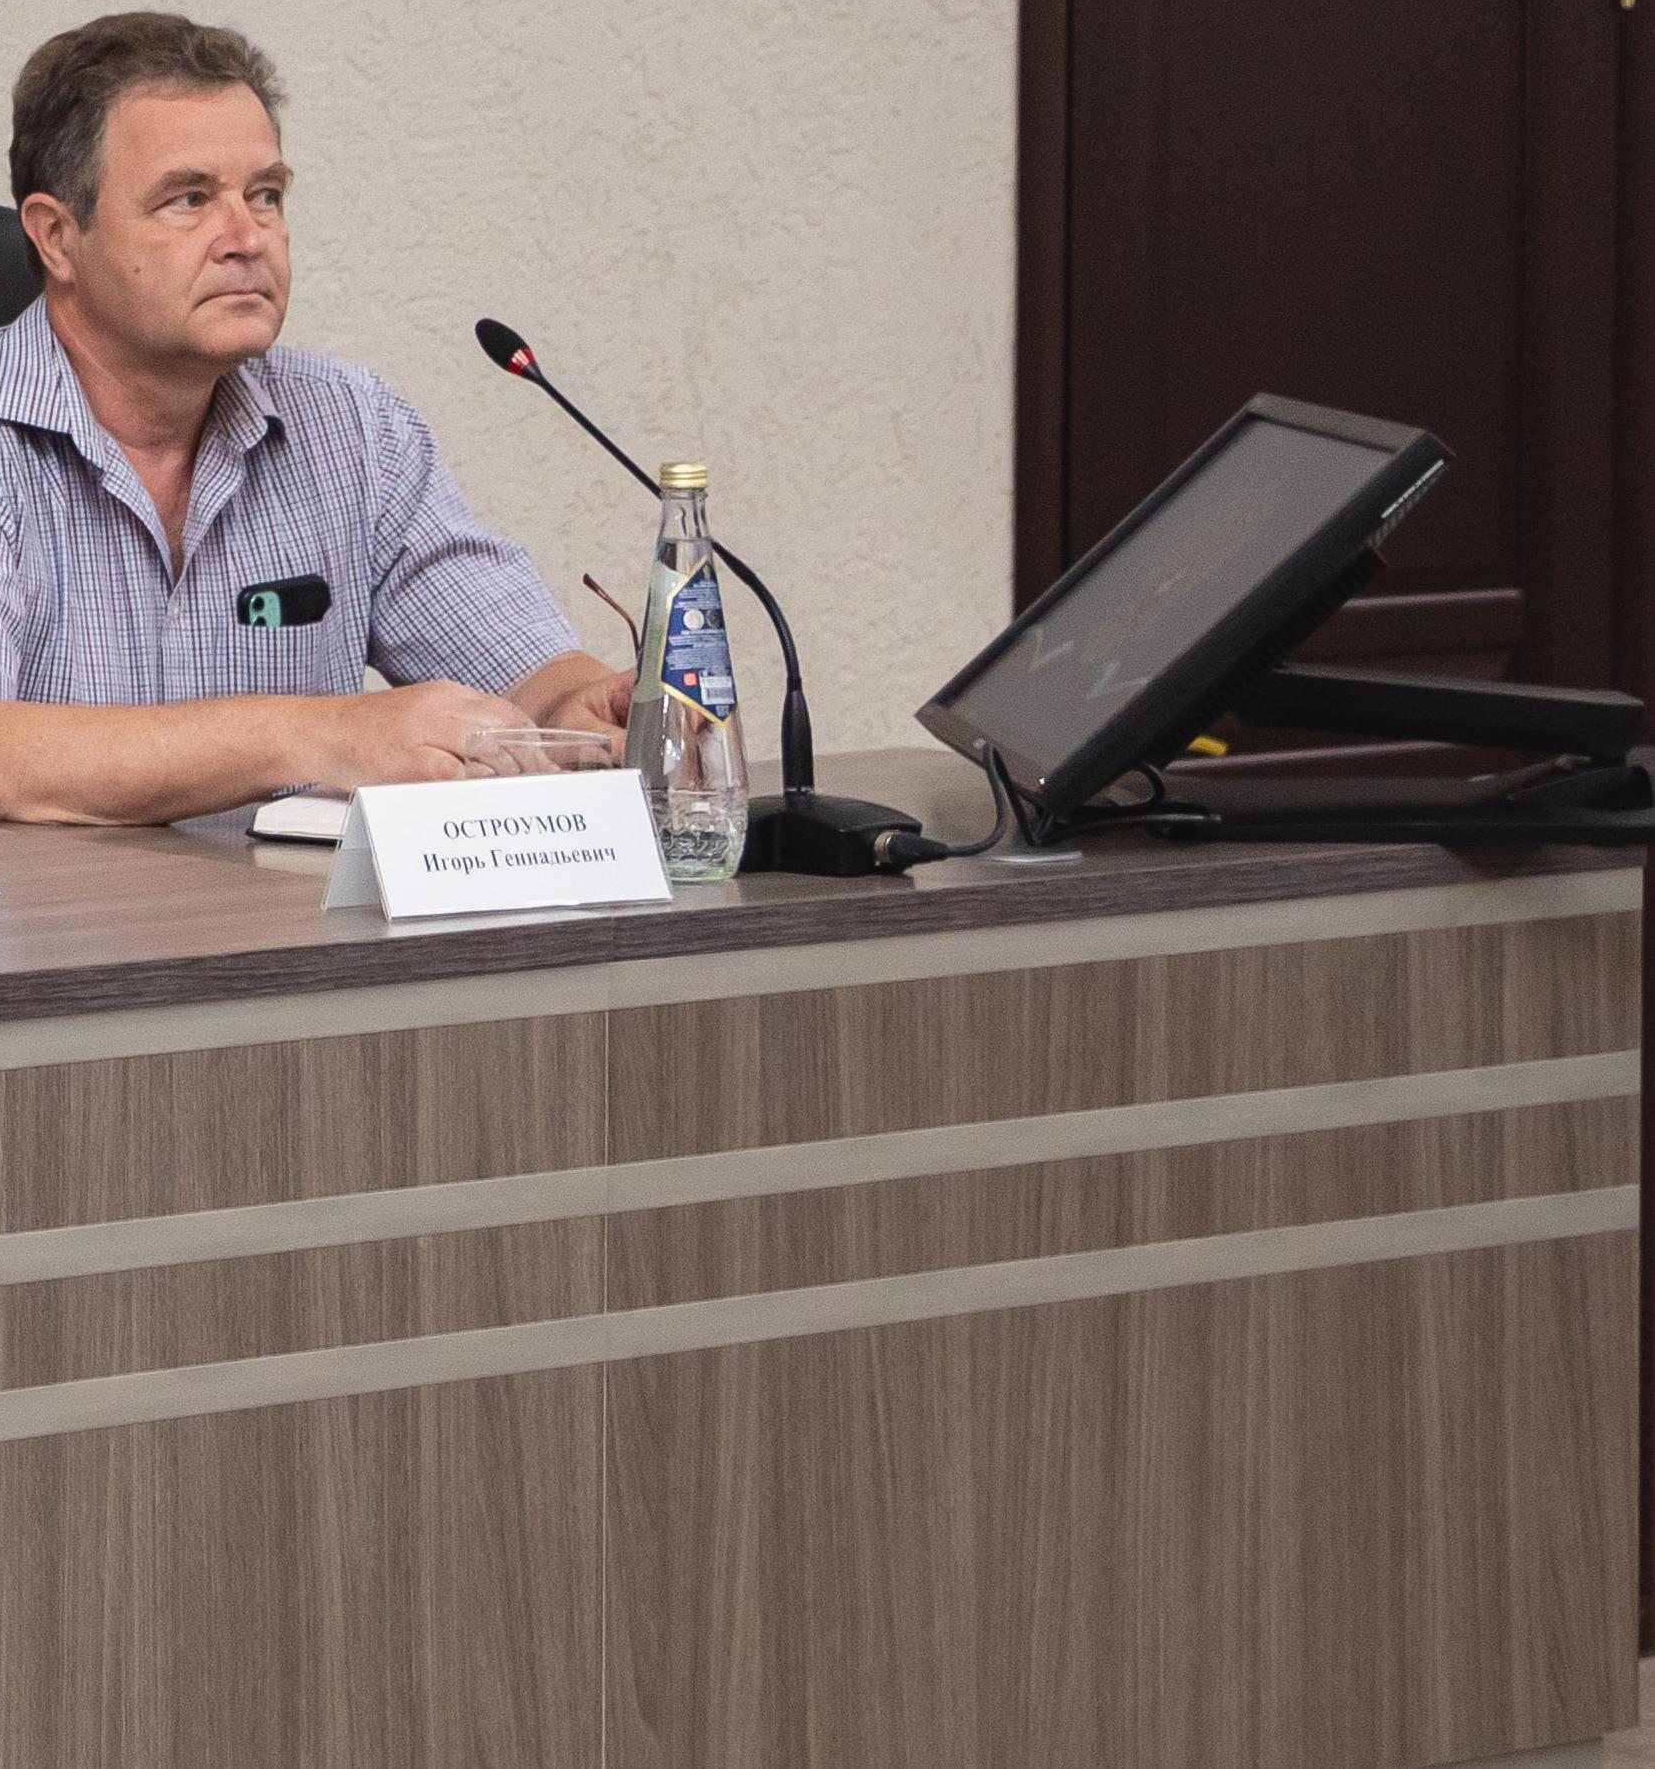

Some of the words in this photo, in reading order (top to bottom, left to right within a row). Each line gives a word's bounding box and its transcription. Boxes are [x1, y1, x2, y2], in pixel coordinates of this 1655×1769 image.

[443, 814, 587, 839] ОСТРОУМОВ
[423, 853, 486, 875] Игорь
[490, 847, 617, 868] Геннадьевич
